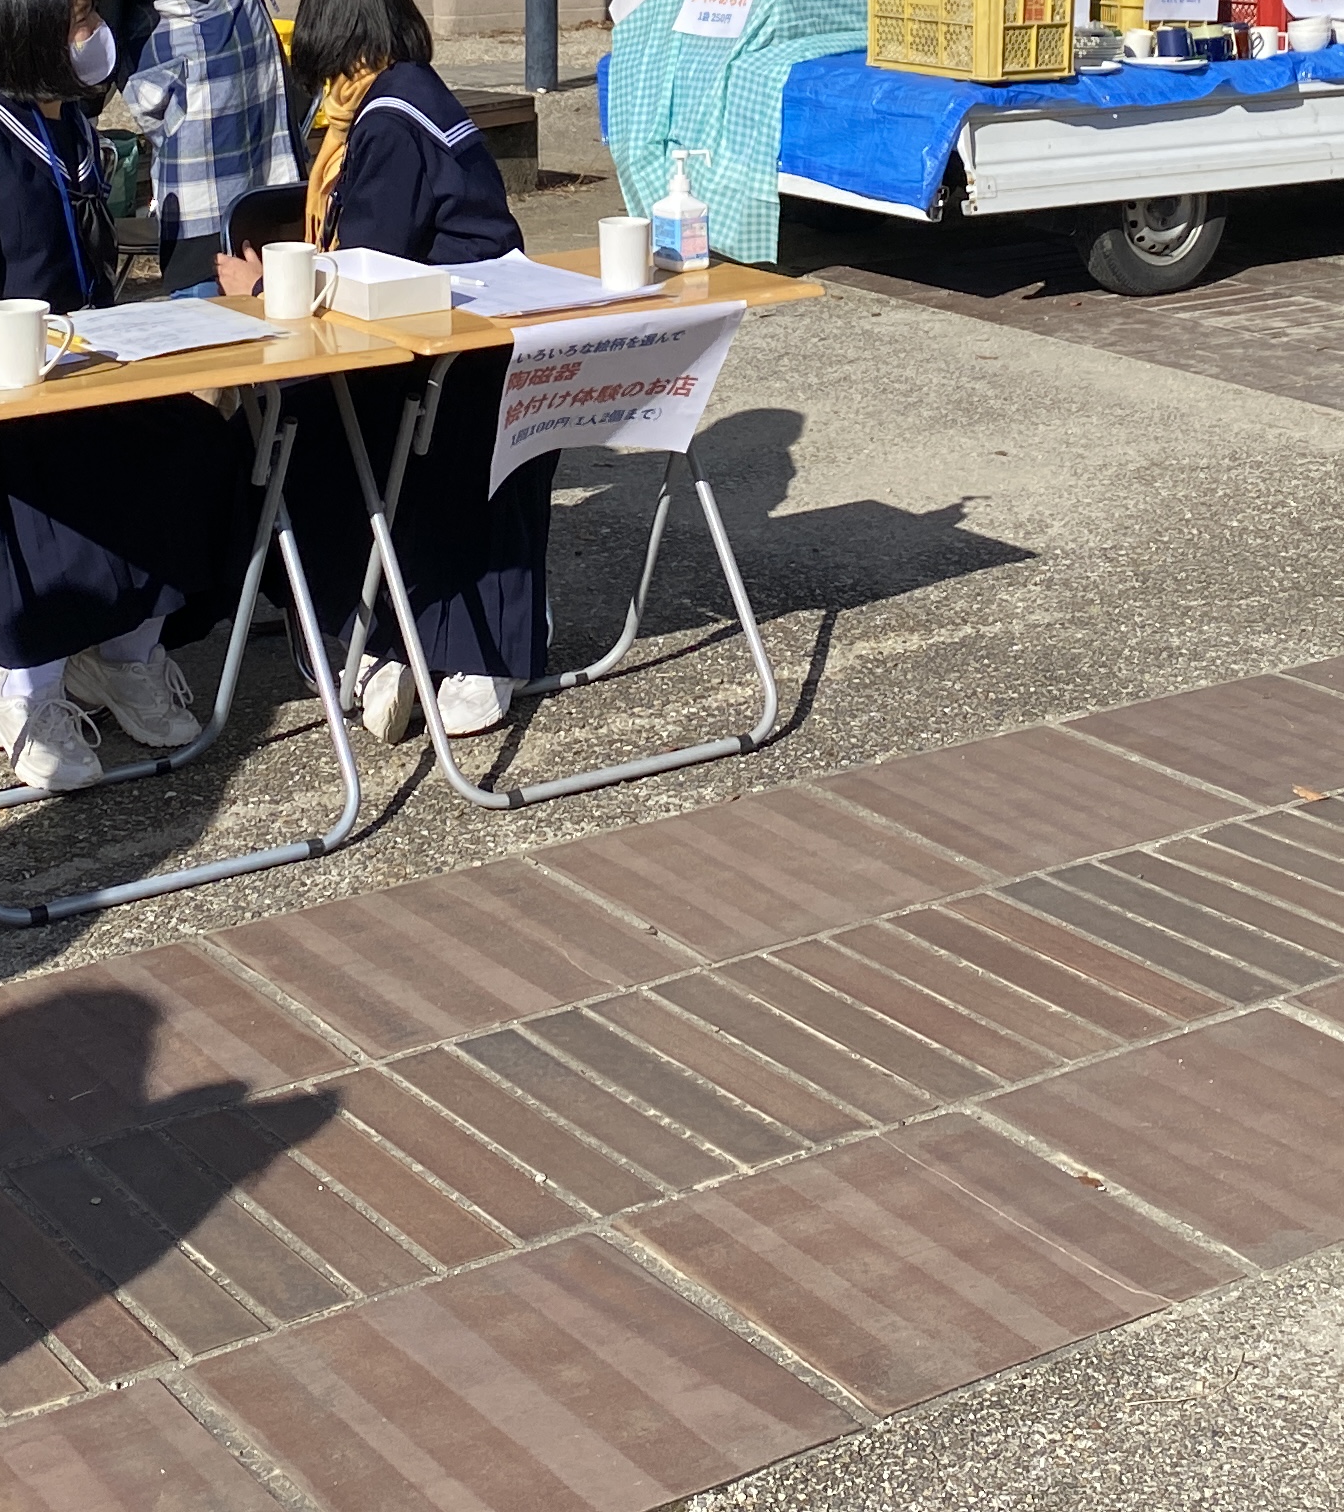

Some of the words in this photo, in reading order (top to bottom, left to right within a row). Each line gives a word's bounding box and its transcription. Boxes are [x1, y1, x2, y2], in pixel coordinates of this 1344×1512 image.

[517, 330, 686, 364] いろいろな絵柄を選んで
[506, 361, 582, 396] 陶磁器
[504, 374, 699, 430] 絵付け体験のお店
